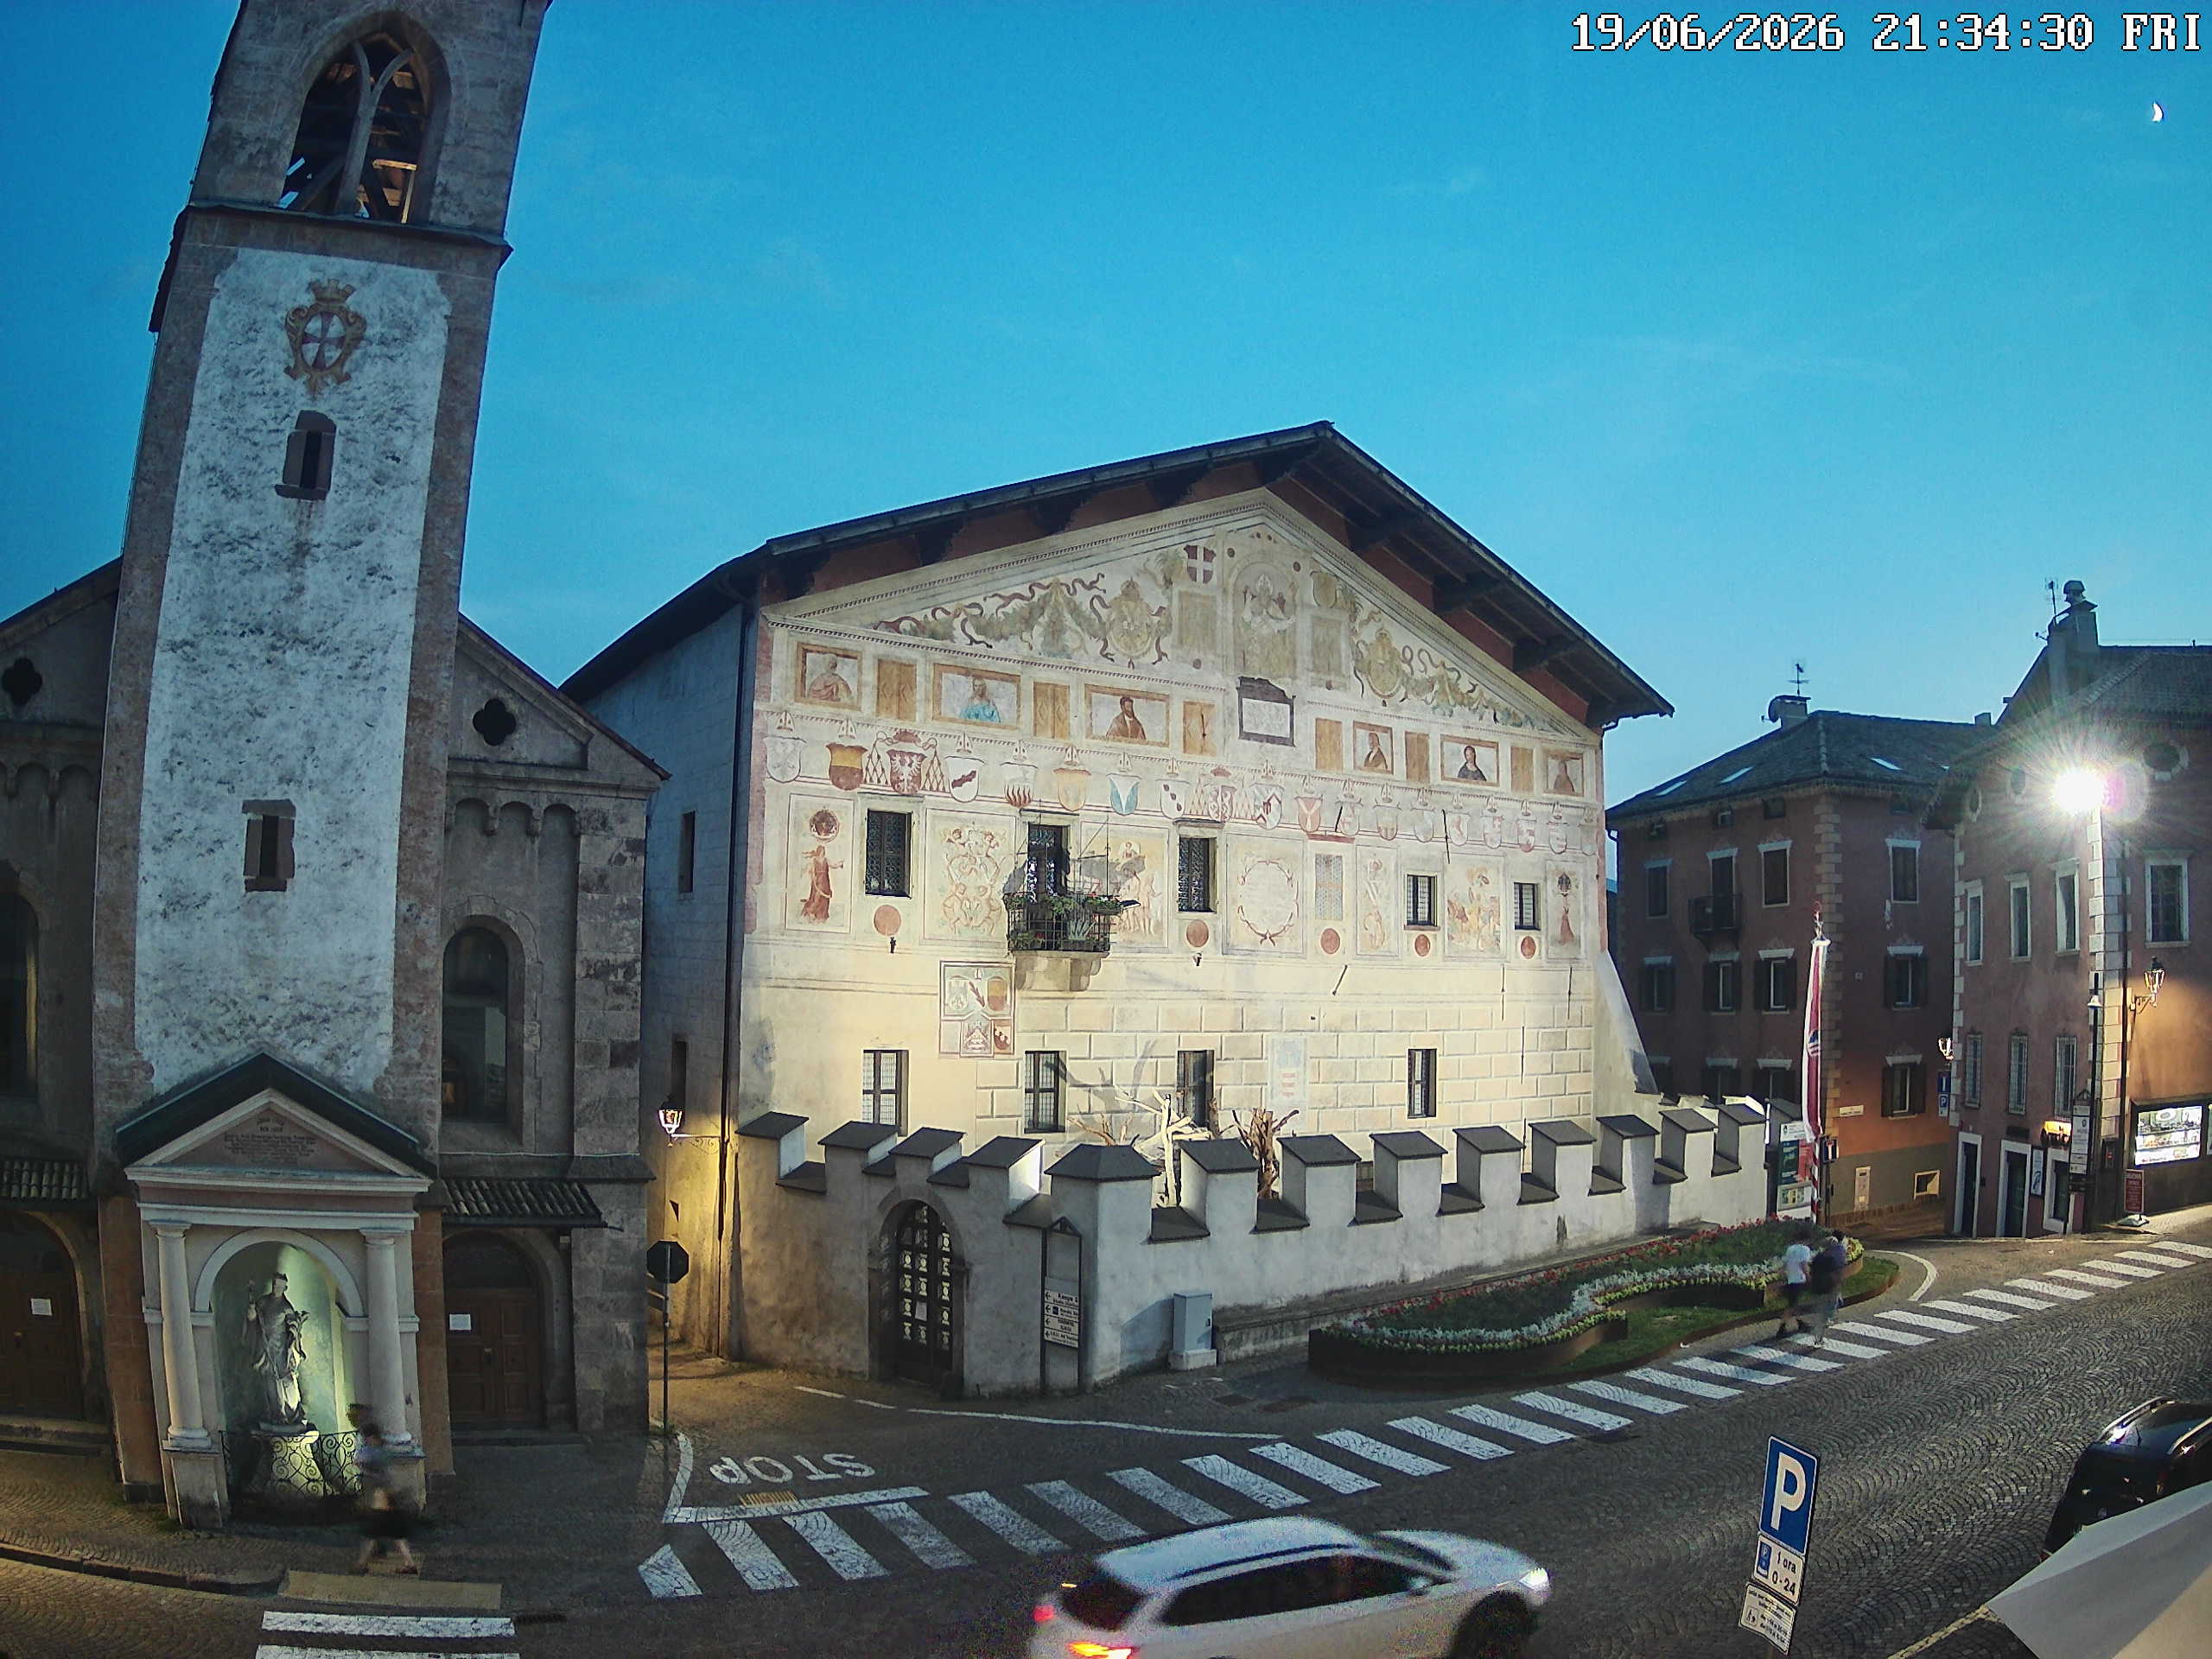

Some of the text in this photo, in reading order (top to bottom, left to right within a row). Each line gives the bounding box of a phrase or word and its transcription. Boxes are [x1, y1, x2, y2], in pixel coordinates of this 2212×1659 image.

[709, 1452, 875, 1484] STOP
[1770, 1452, 1806, 1531] P
[1783, 1558, 1796, 1574] ora
